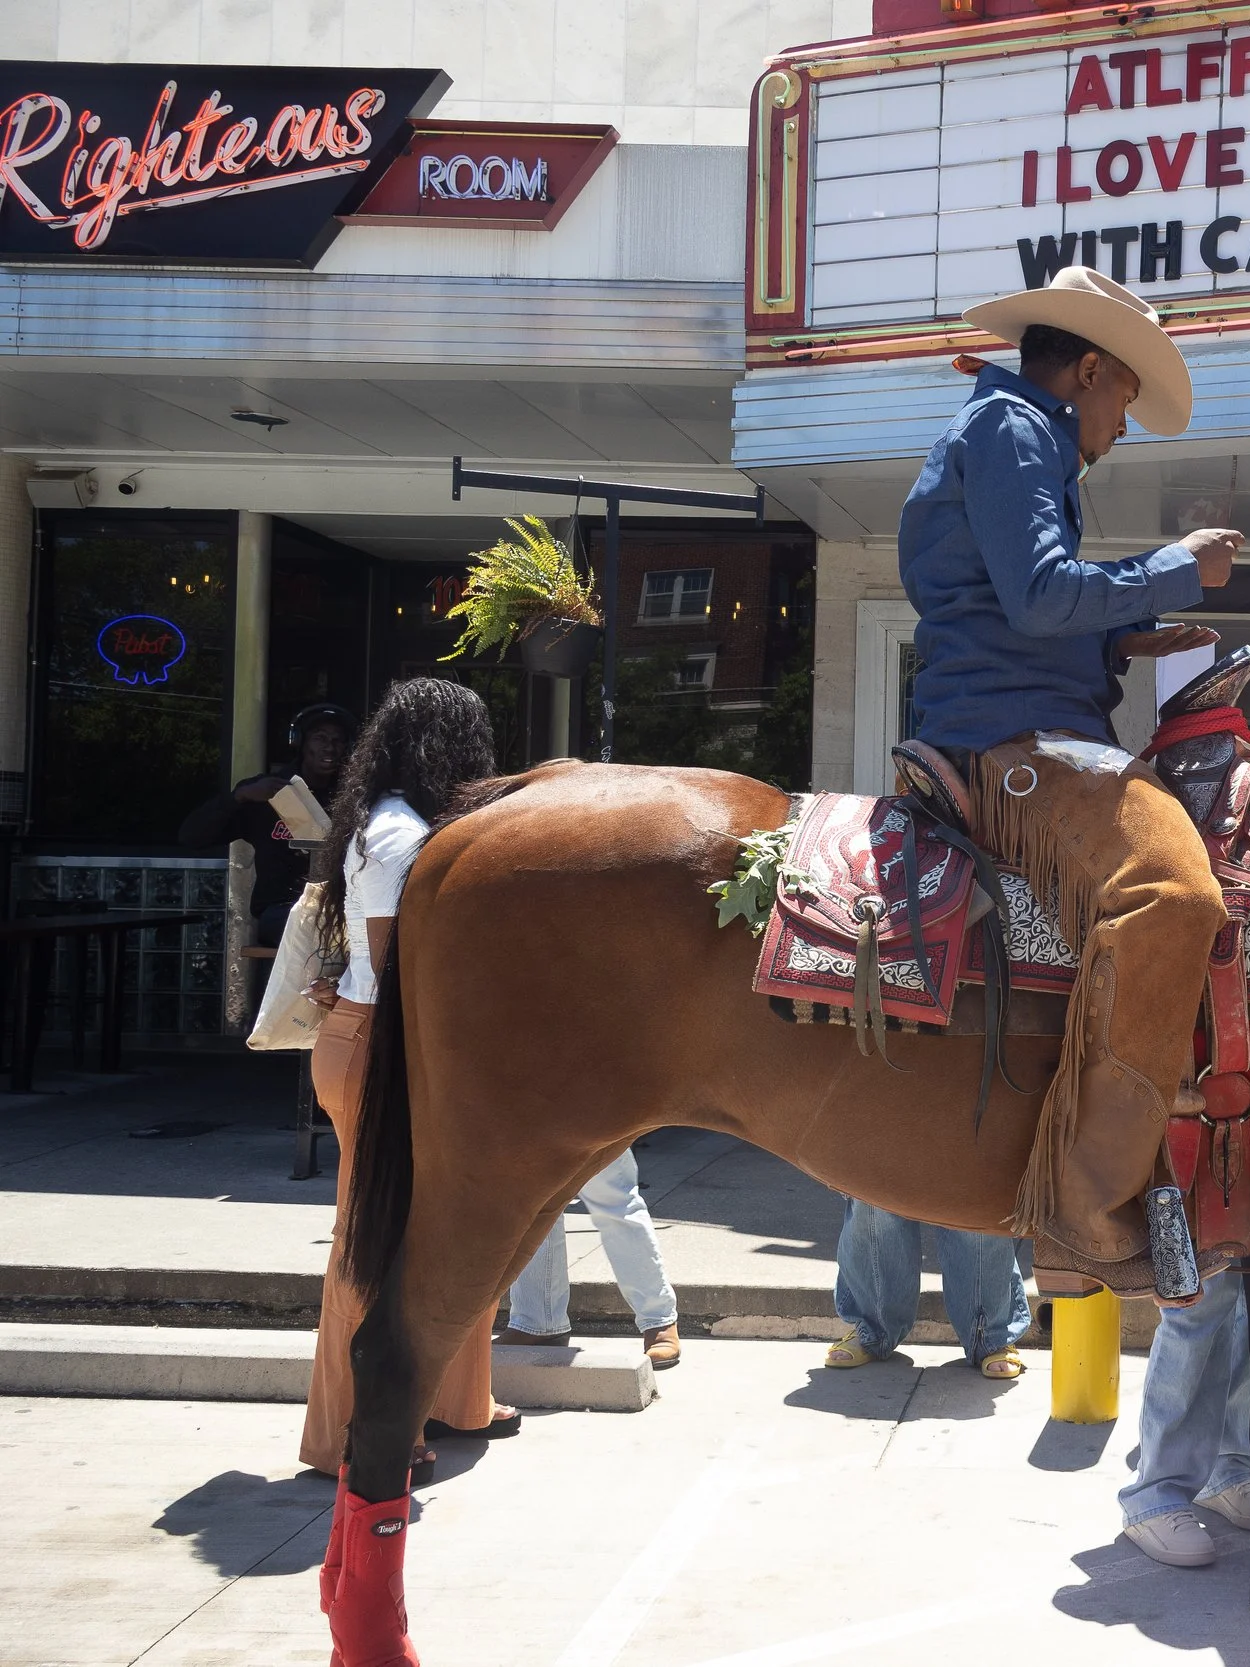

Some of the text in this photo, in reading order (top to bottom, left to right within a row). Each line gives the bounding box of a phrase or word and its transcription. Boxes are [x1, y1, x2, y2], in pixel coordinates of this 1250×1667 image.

[0, 79, 386, 250] Righteous
[418, 155, 550, 202] ROOM
[1022, 150, 1038, 208] I
[1056, 127, 1246, 204] LOVE
[1017, 220, 1184, 292] WITH
